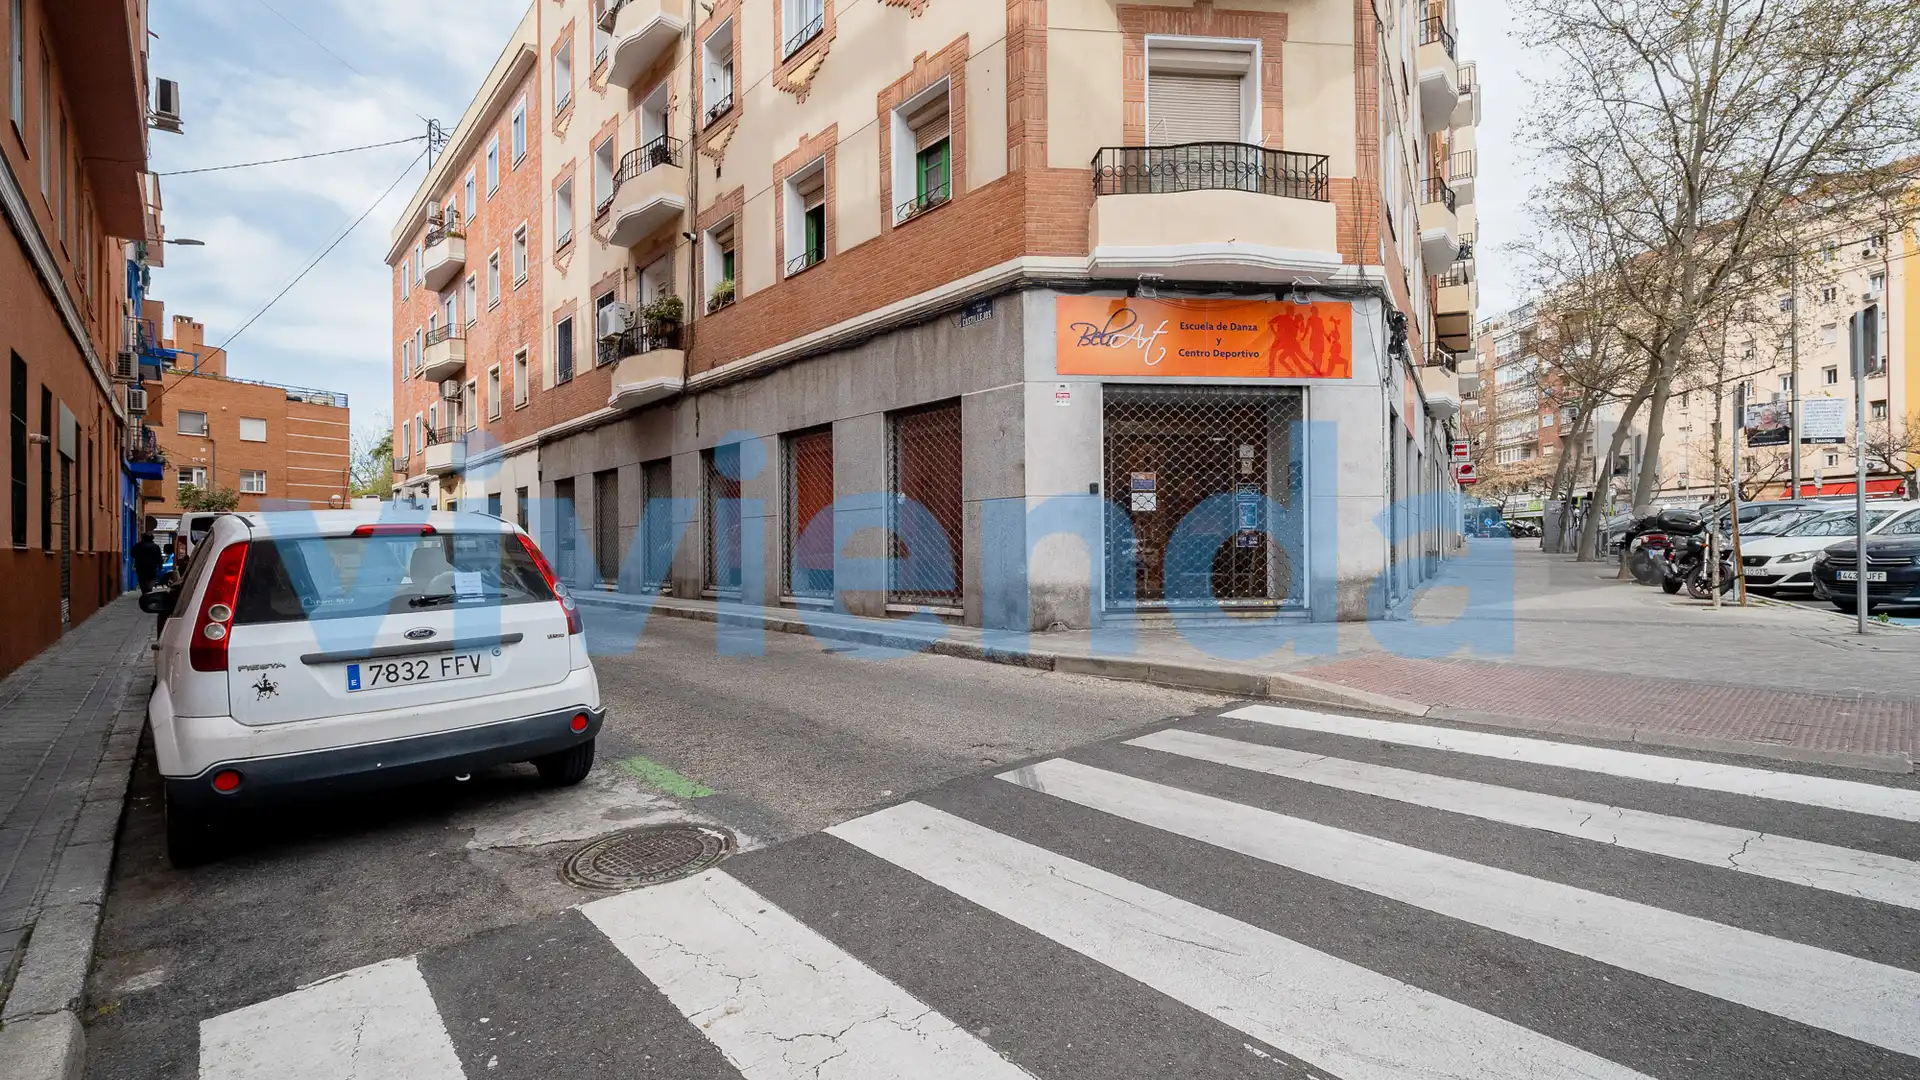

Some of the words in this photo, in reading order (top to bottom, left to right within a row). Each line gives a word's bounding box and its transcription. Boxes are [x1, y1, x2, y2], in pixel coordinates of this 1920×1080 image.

[962, 310, 992, 327] CASTILLEJOS
[1179, 321, 1213, 331] Escuela
[1216, 321, 1228, 331] de
[1230, 322, 1258, 332] Danza
[1216, 337, 1222, 346] y
[1178, 348, 1211, 357] Centro
[1213, 349, 1260, 360] Deportivo
[1842, 572, 1858, 580] 443
[237, 662, 286, 672] FIESTA
[368, 660, 430, 686] 7832
[440, 654, 481, 677] FFV
